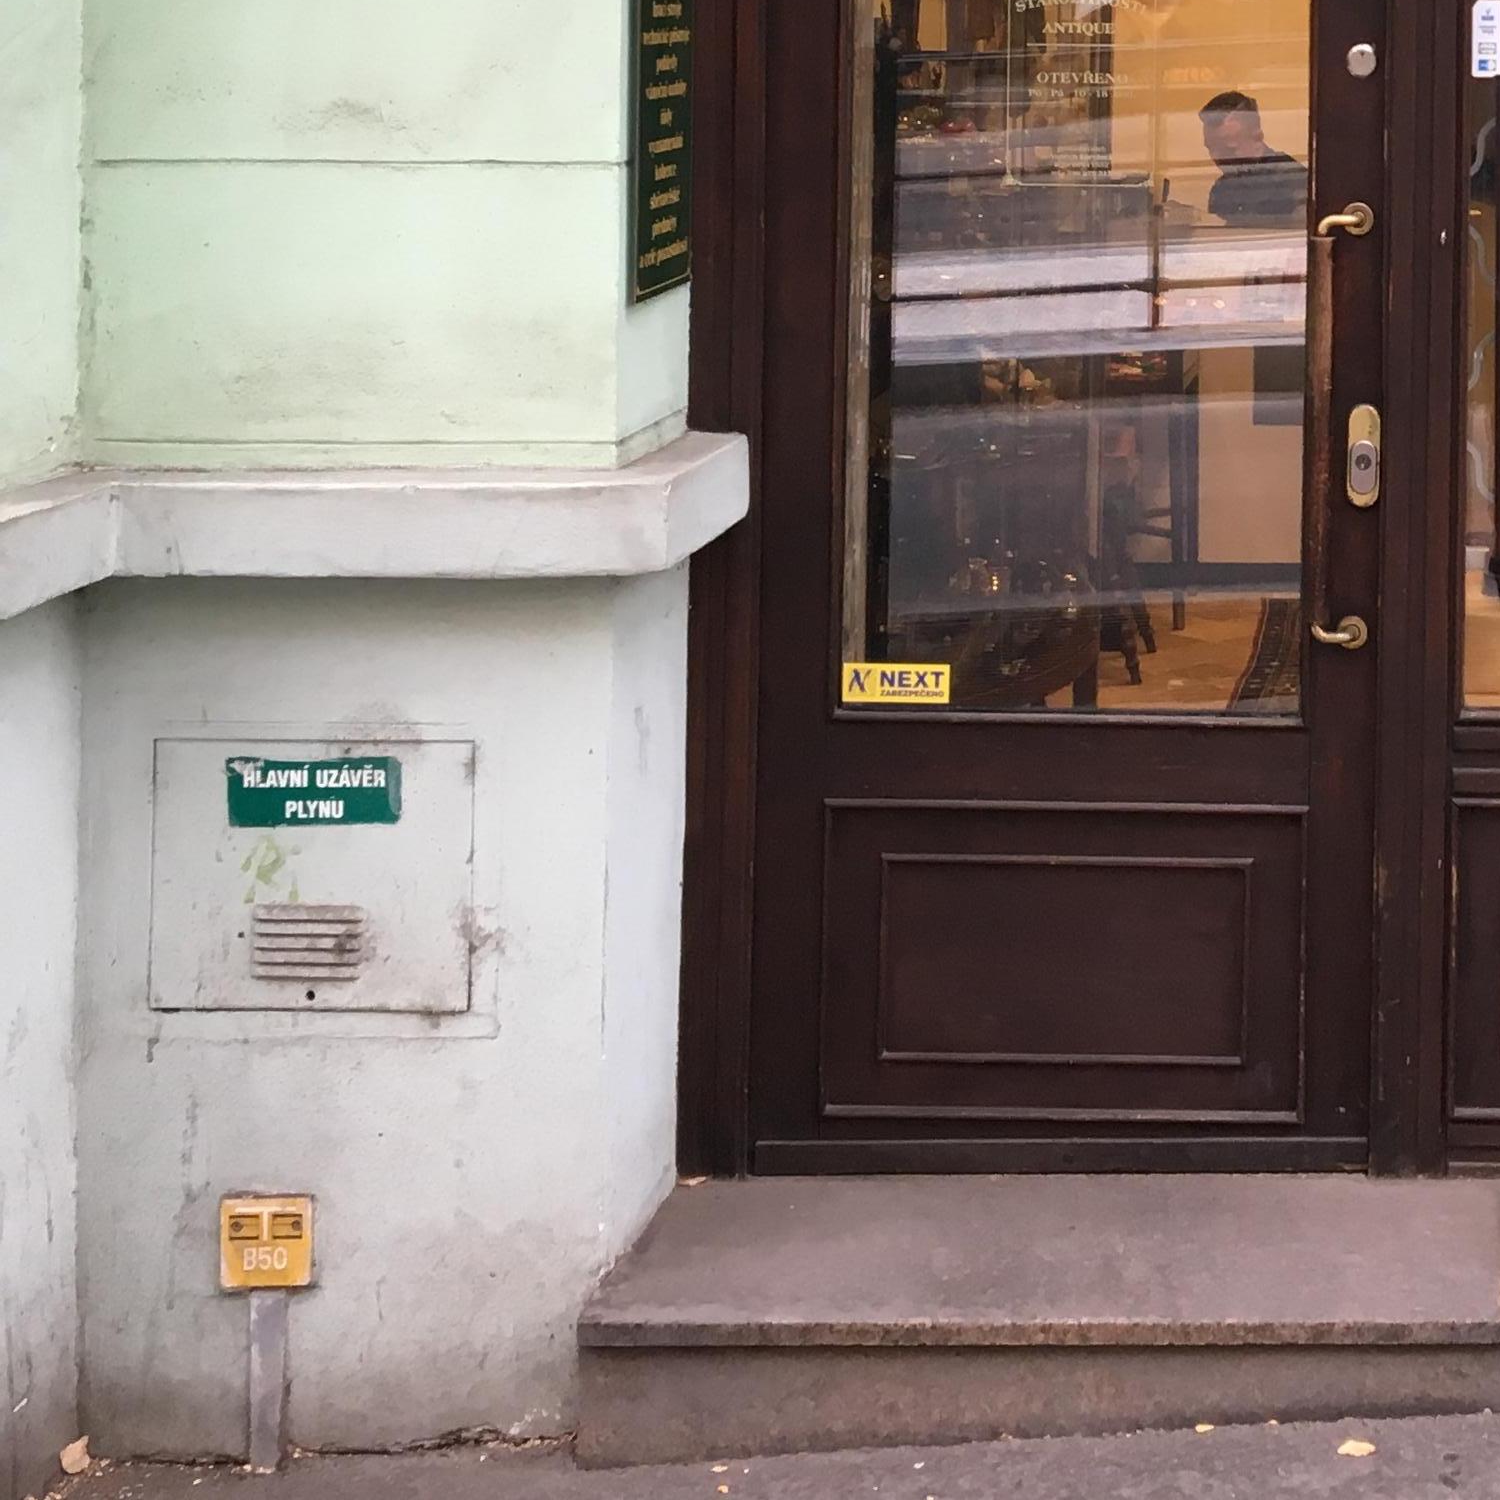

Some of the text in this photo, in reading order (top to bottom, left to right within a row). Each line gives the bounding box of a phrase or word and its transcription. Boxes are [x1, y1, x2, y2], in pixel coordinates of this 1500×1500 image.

[880, 670, 945, 689] NEXT
[242, 764, 386, 788] HLAVNÍ UZÁVĚR
[243, 1246, 288, 1271] B50
